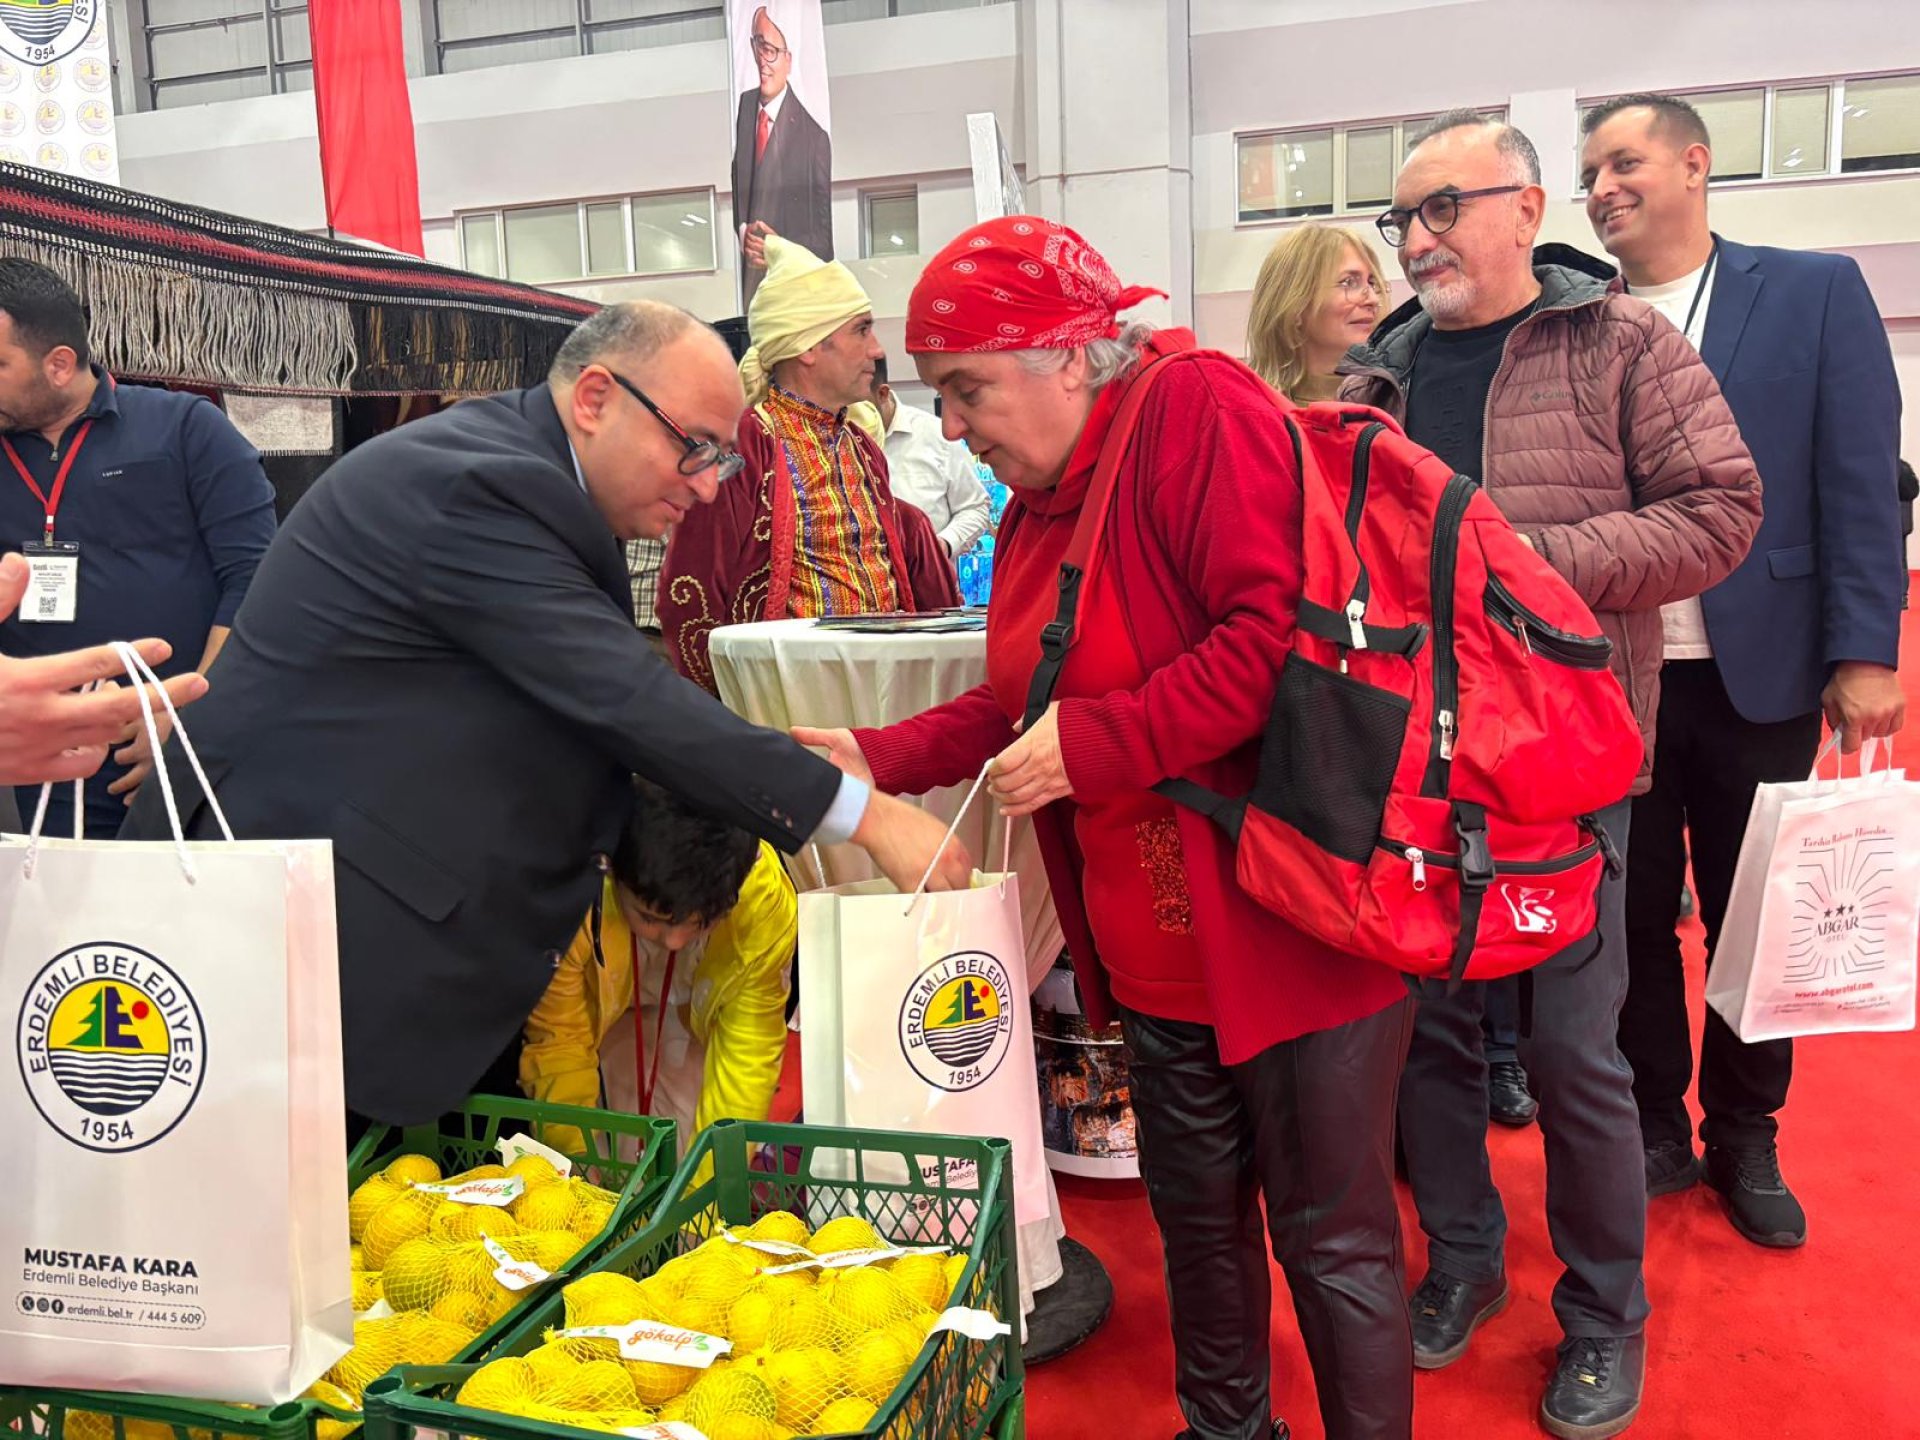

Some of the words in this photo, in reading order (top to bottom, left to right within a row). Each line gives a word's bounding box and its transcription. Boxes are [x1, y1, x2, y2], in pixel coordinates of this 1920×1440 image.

[25, 44, 55, 60] 1954
[1814, 916, 1859, 937] ABGAR
[907, 963, 950, 1049] ERDEMLİ
[955, 959, 1009, 1033] BELEDİYESİ
[28, 954, 86, 1074] ERDEMLİ
[93, 954, 194, 1087] BELEDİYESİ
[948, 1065, 982, 1085] 1954
[80, 1117, 134, 1143] 1954
[24, 1247, 127, 1273] MUSTAFA
[133, 1257, 198, 1278] KARA
[23, 1268, 75, 1285] Erdemli
[78, 1274, 138, 1293] Belediye
[142, 1279, 199, 1296] Başkanı
[67, 1304, 133, 1319] erdemli.bel.tr
[147, 1311, 167, 1322] 444
[170, 1312, 177, 1323] 5
[180, 1312, 201, 1325] 609
[627, 1327, 692, 1351] gökalp
